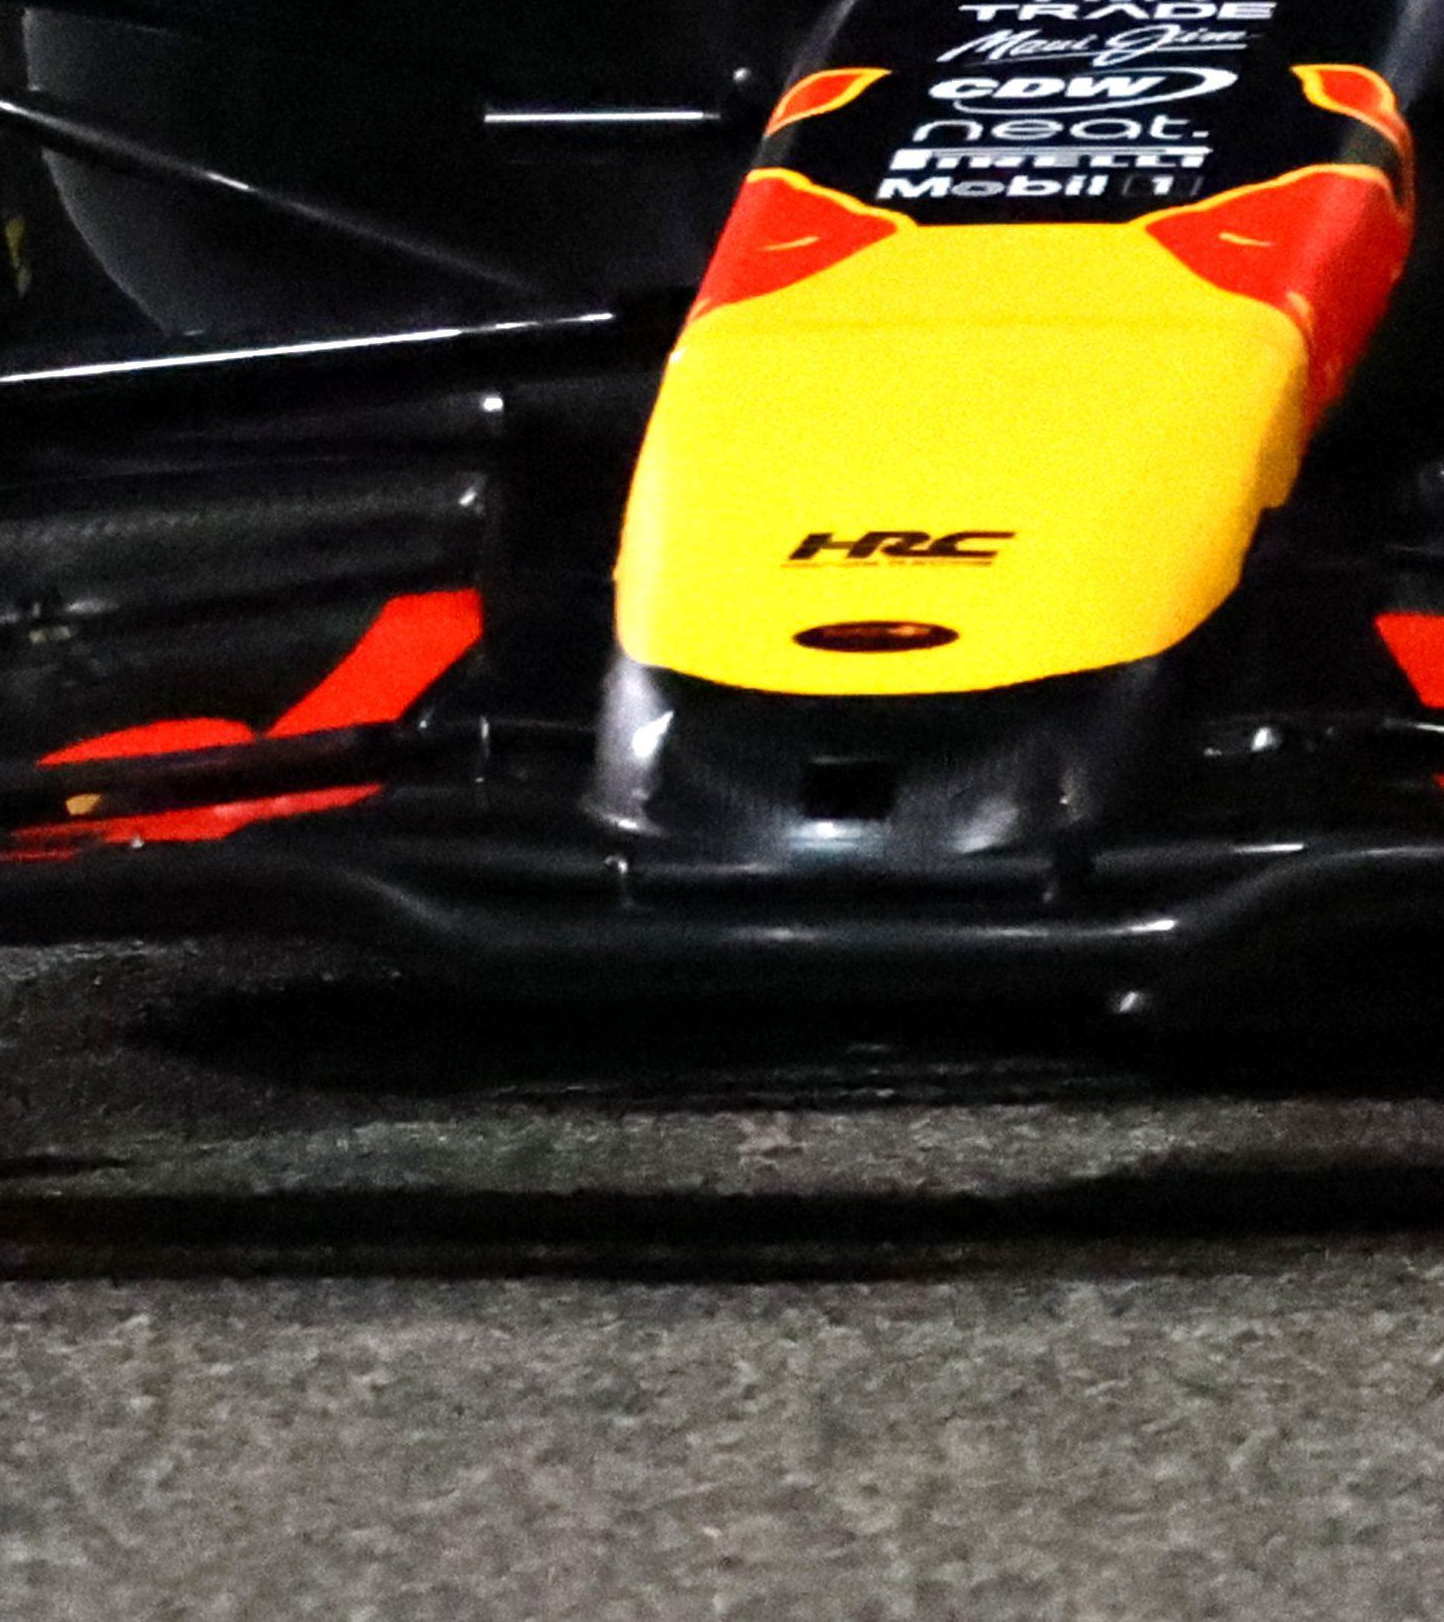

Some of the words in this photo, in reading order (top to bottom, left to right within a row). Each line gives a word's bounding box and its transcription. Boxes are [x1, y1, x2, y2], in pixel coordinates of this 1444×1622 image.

[928, 76, 1169, 100] CDW
[888, 146, 1214, 171] PIRELLI
[875, 174, 1111, 200] Mobil
[787, 530, 1018, 561] HRC
